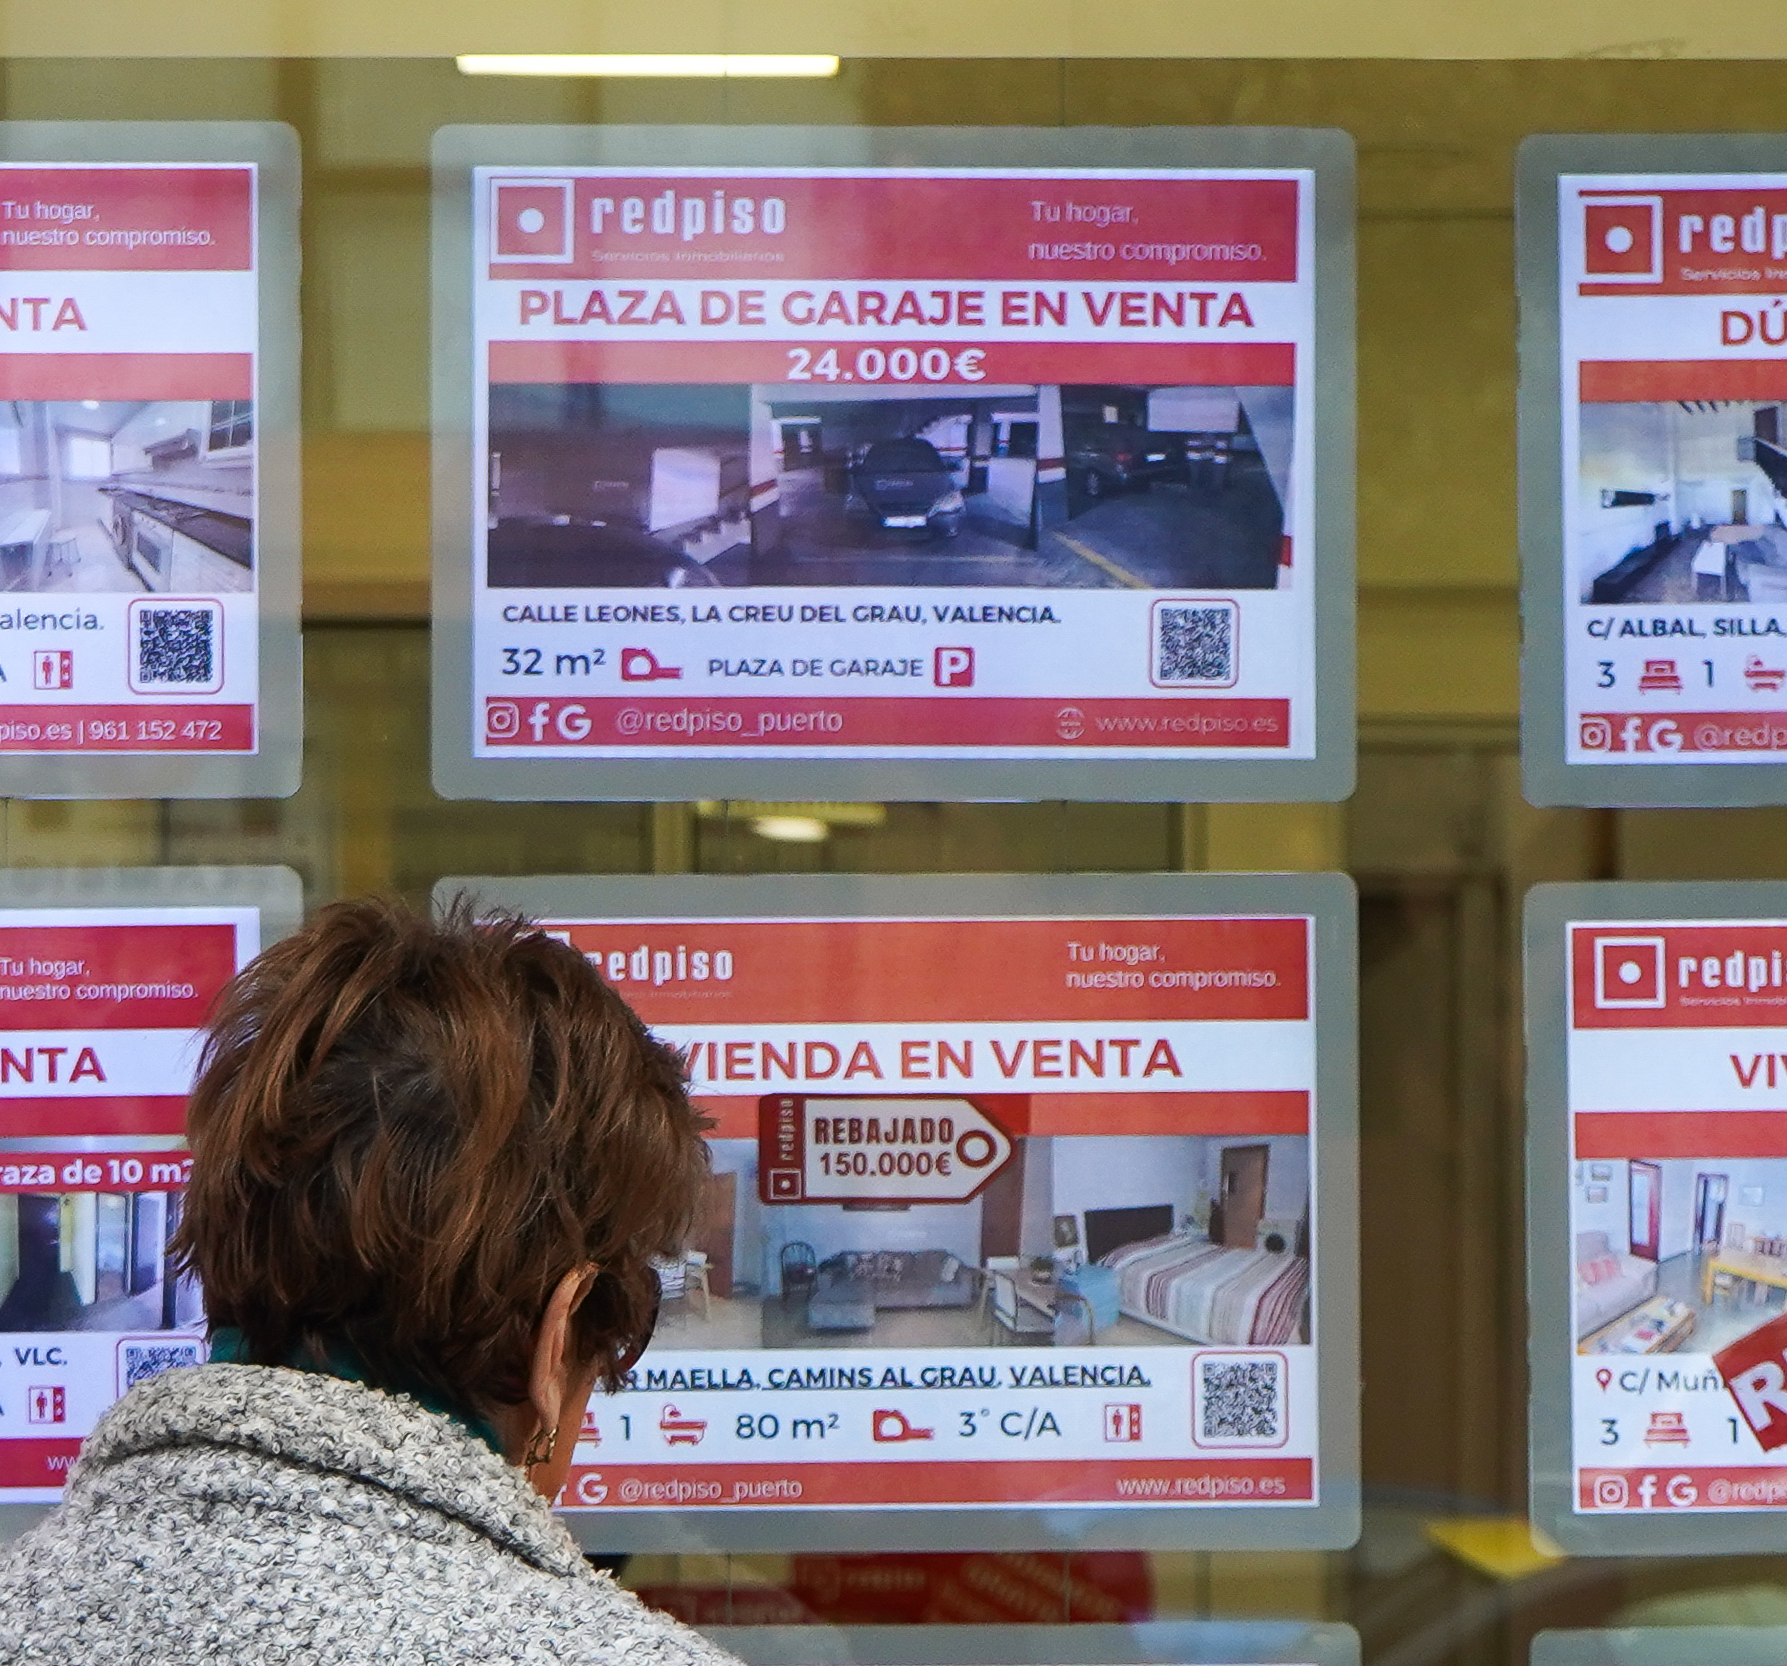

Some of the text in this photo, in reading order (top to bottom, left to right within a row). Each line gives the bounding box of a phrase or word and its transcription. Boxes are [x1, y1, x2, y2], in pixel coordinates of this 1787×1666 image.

[592, 189, 786, 241] redpiso
[520, 289, 1255, 328] PLAZA DE GARAJE EN VENTA
[785, 346, 986, 382] 24.000€
[616, 707, 843, 737] @redpiso_puerto
[900, 1038, 1183, 1079] EN VENTA
[814, 1117, 954, 1145] REBAJADO
[61, 1158, 103, 1185] de
[108, 1158, 144, 1184] 10
[819, 1151, 952, 1177] 150.000€
